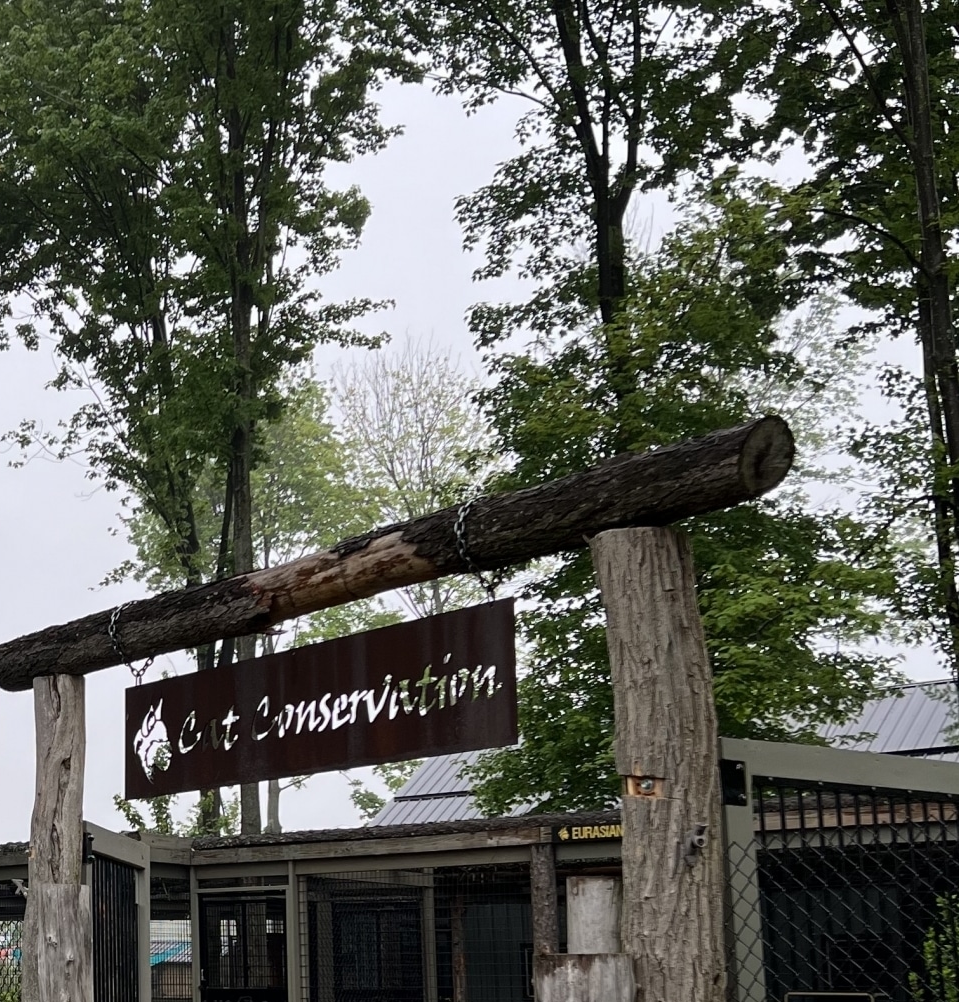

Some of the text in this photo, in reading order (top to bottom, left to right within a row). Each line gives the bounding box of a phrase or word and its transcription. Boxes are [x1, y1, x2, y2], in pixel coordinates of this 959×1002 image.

[178, 652, 503, 754] Cat Conservation
[572, 825, 623, 840] EURASIAN
